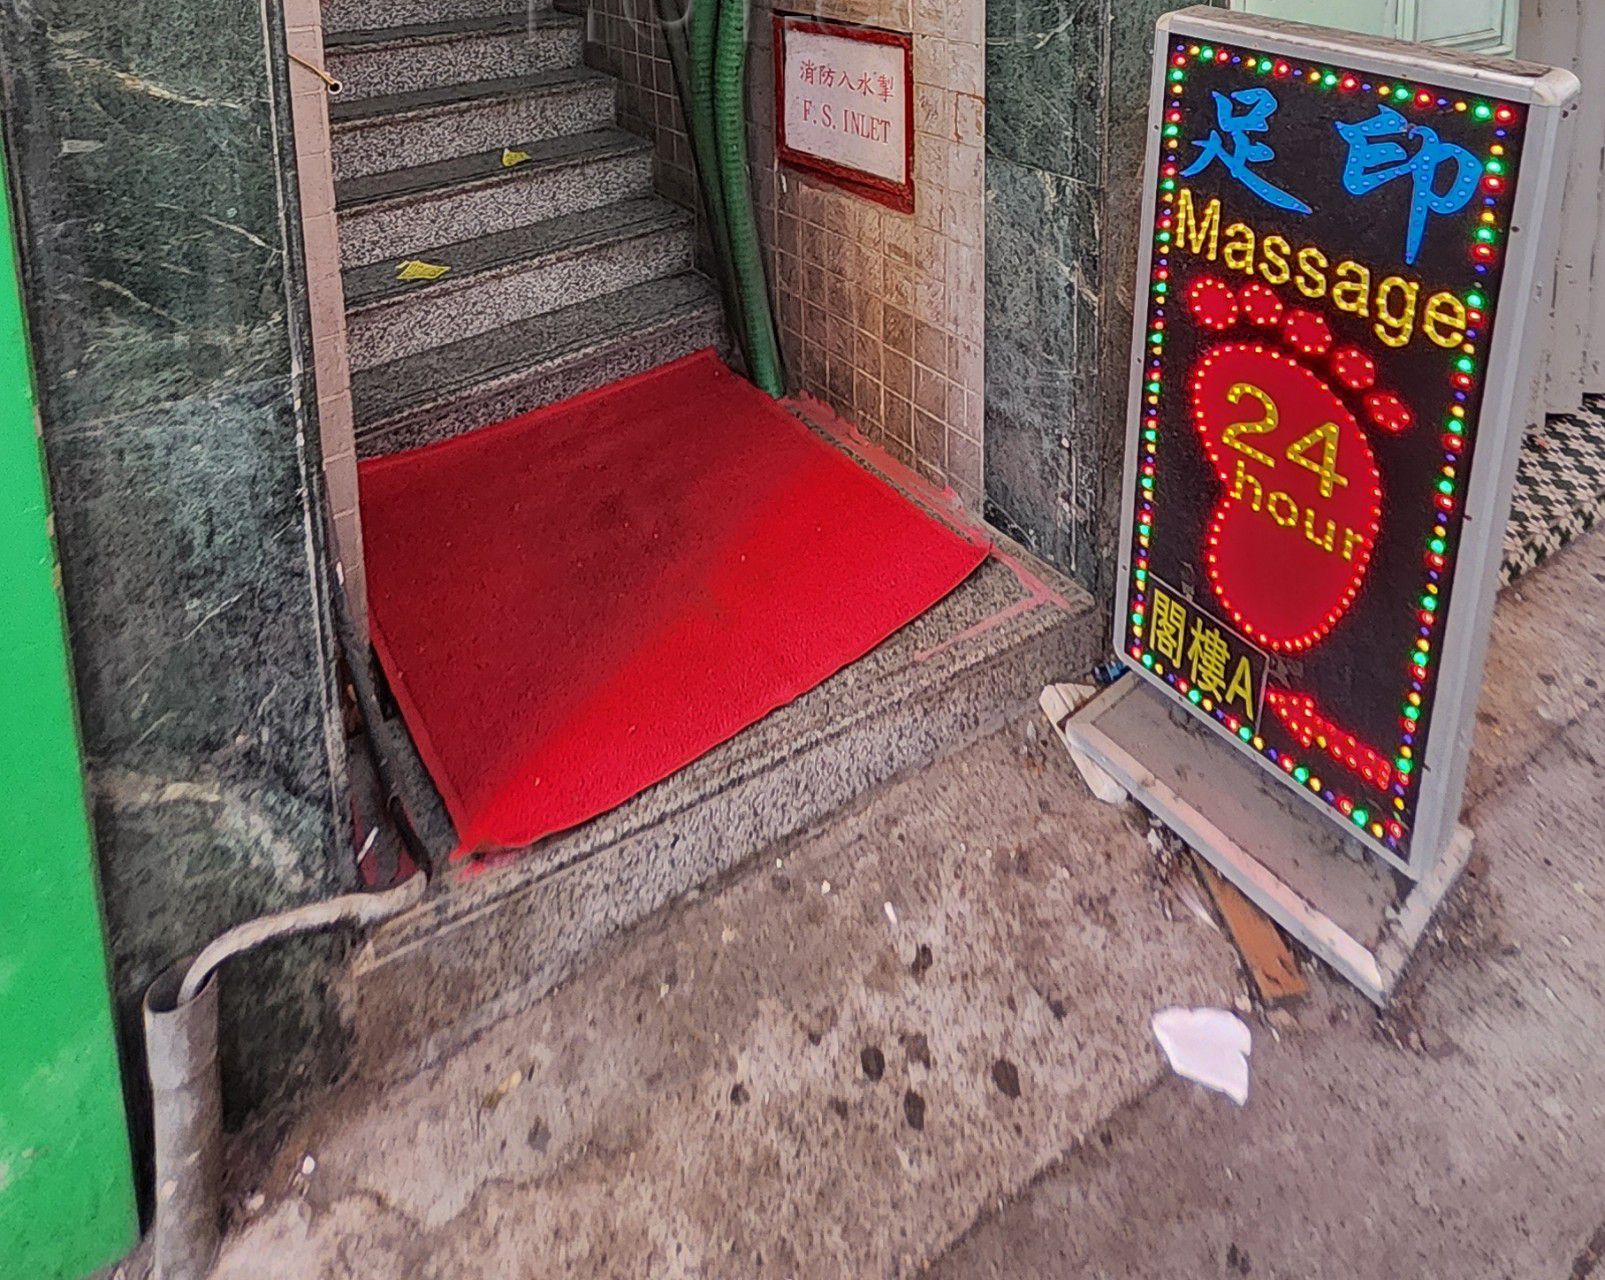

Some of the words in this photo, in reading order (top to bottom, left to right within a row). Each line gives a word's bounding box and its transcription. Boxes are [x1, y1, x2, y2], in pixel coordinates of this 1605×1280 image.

[800, 58, 894, 103] 消防入水掣
[843, 109, 891, 144] INLET
[1180, 87, 1483, 265] 足印
[1175, 188, 1467, 348] Massage
[1221, 382, 1348, 498] 24
[1231, 460, 1364, 561] hour
[1148, 587, 1255, 722] 閣樓A
